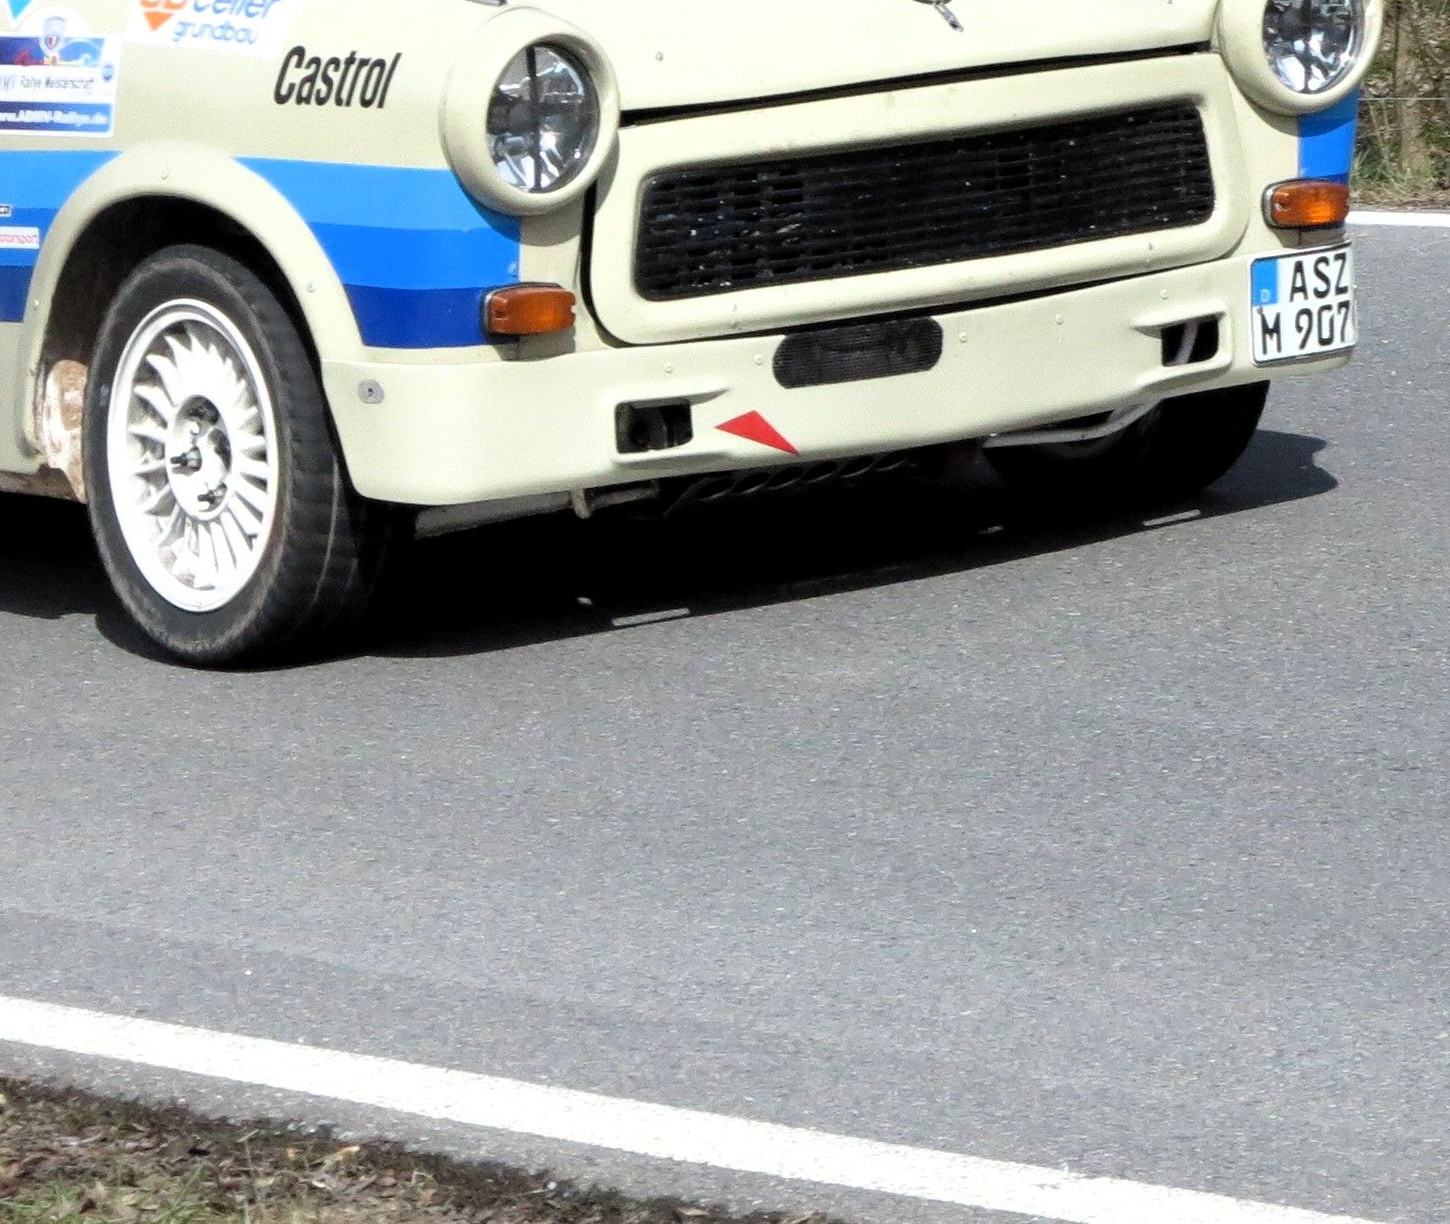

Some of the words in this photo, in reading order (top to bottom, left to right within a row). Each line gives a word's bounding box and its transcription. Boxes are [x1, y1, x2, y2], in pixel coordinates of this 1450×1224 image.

[274, 45, 403, 109] Castrol
[1289, 252, 1348, 303] ASZ
[1259, 309, 1282, 355] M
[1294, 299, 1351, 350] 907
